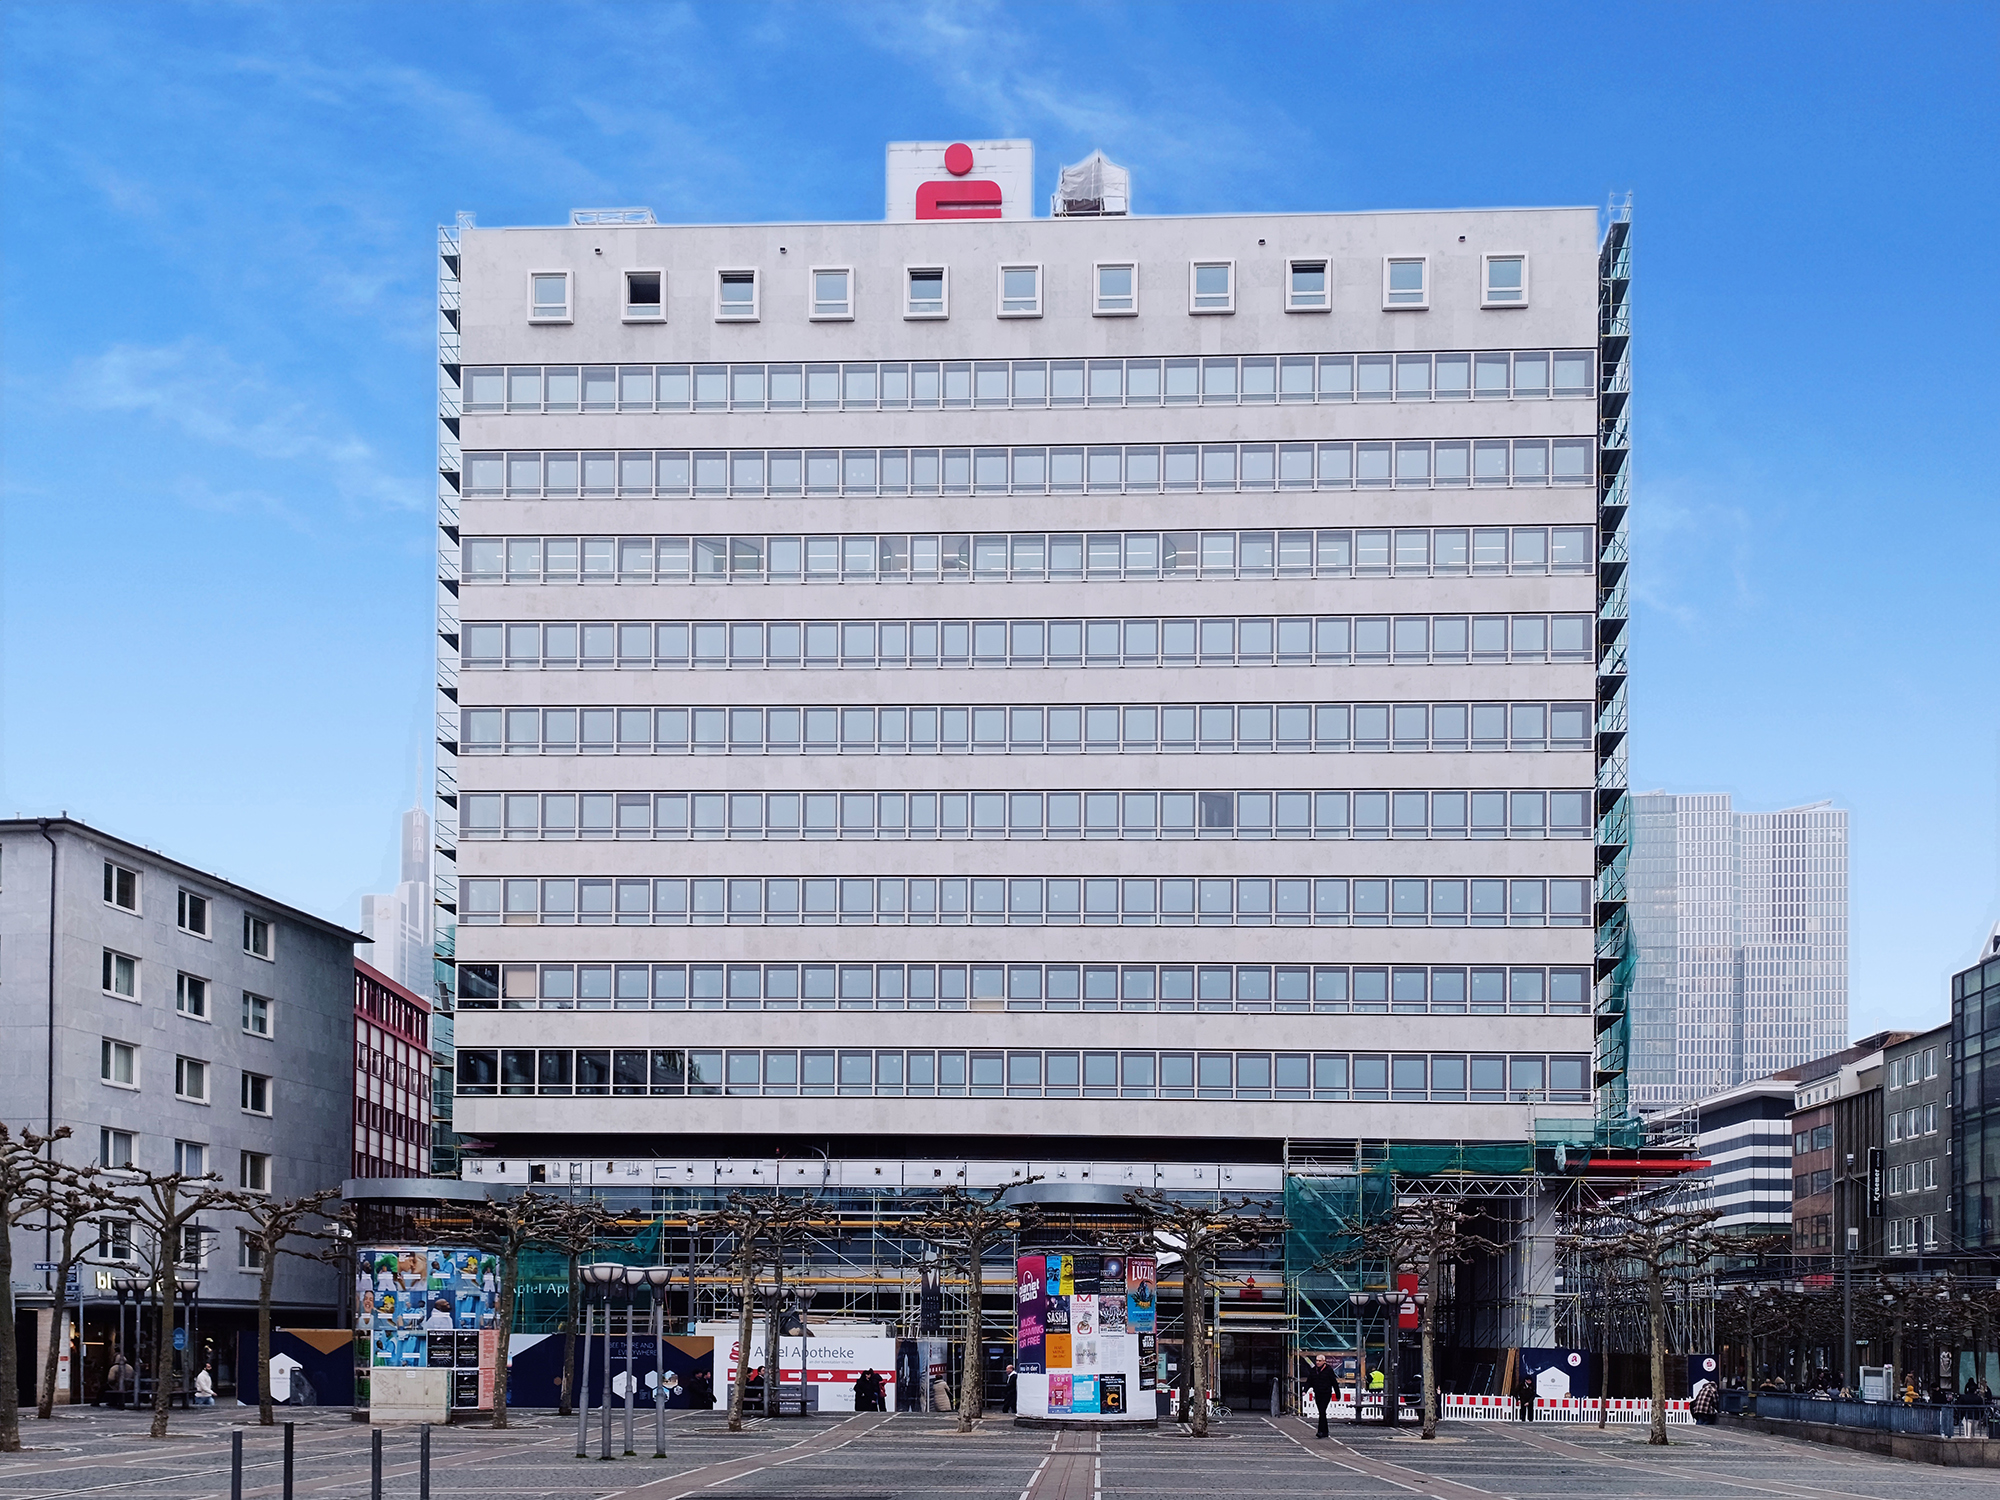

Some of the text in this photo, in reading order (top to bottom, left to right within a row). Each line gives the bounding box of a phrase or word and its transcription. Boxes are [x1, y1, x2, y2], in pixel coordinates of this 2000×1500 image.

[1047, 1311, 1068, 1324] SASHA
[1027, 1335, 1041, 1346] FREE
[754, 1346, 788, 1358] Ael
